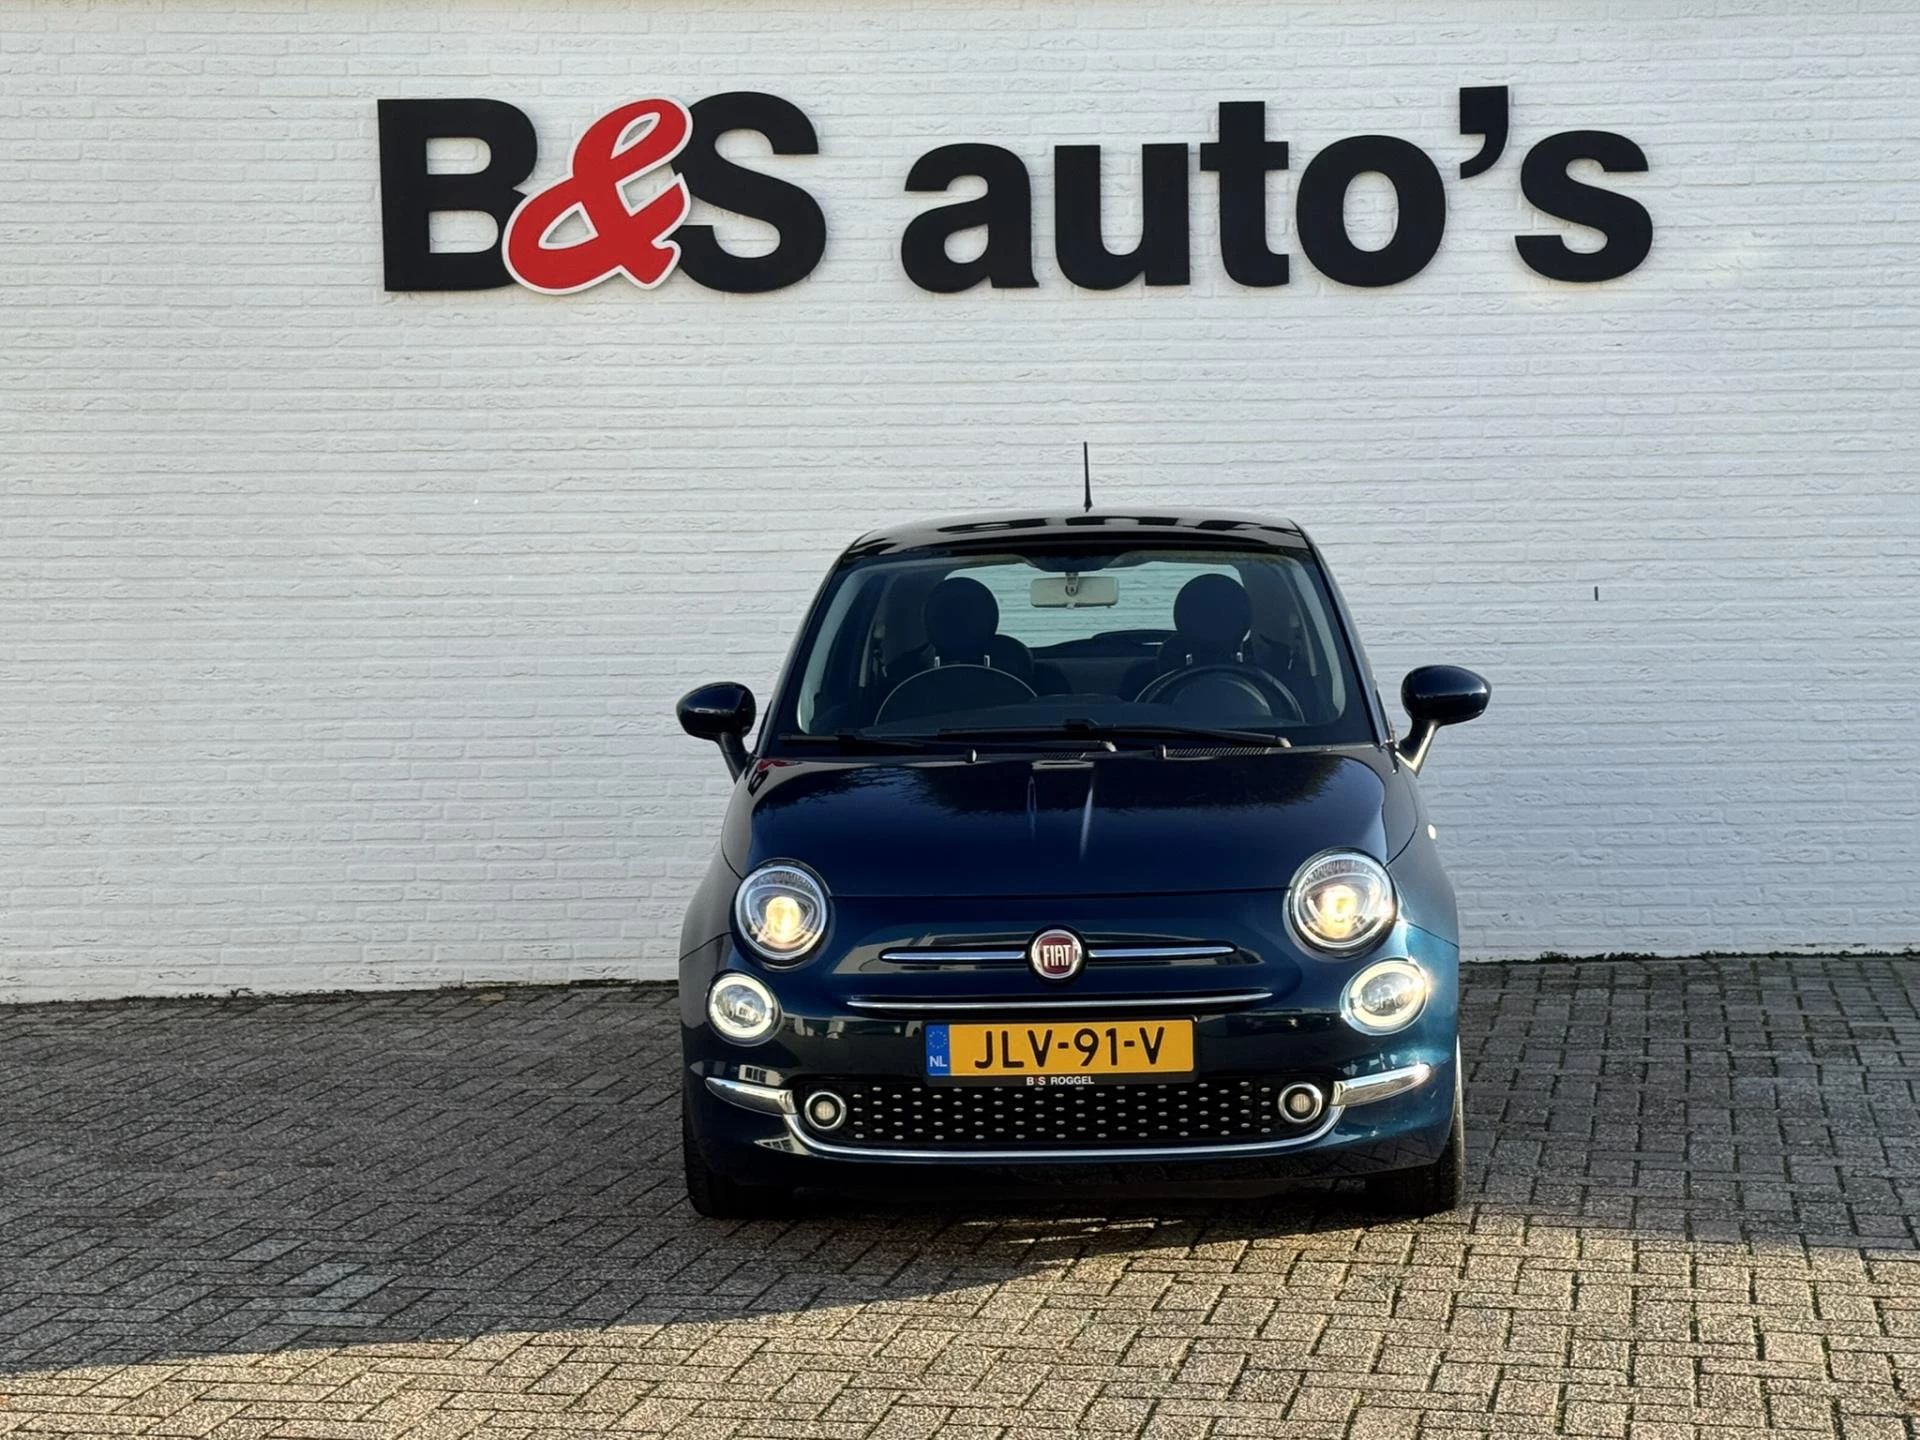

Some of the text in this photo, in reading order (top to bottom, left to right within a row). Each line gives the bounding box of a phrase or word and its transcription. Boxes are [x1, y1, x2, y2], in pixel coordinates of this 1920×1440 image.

[378, 85, 1653, 295] B&S auto's
[1043, 945, 1071, 967] FIAT
[974, 1026, 1165, 1069] JLV-91-V
[929, 1055, 947, 1067] NL
[1050, 1075, 1095, 1085] ROGGEL
